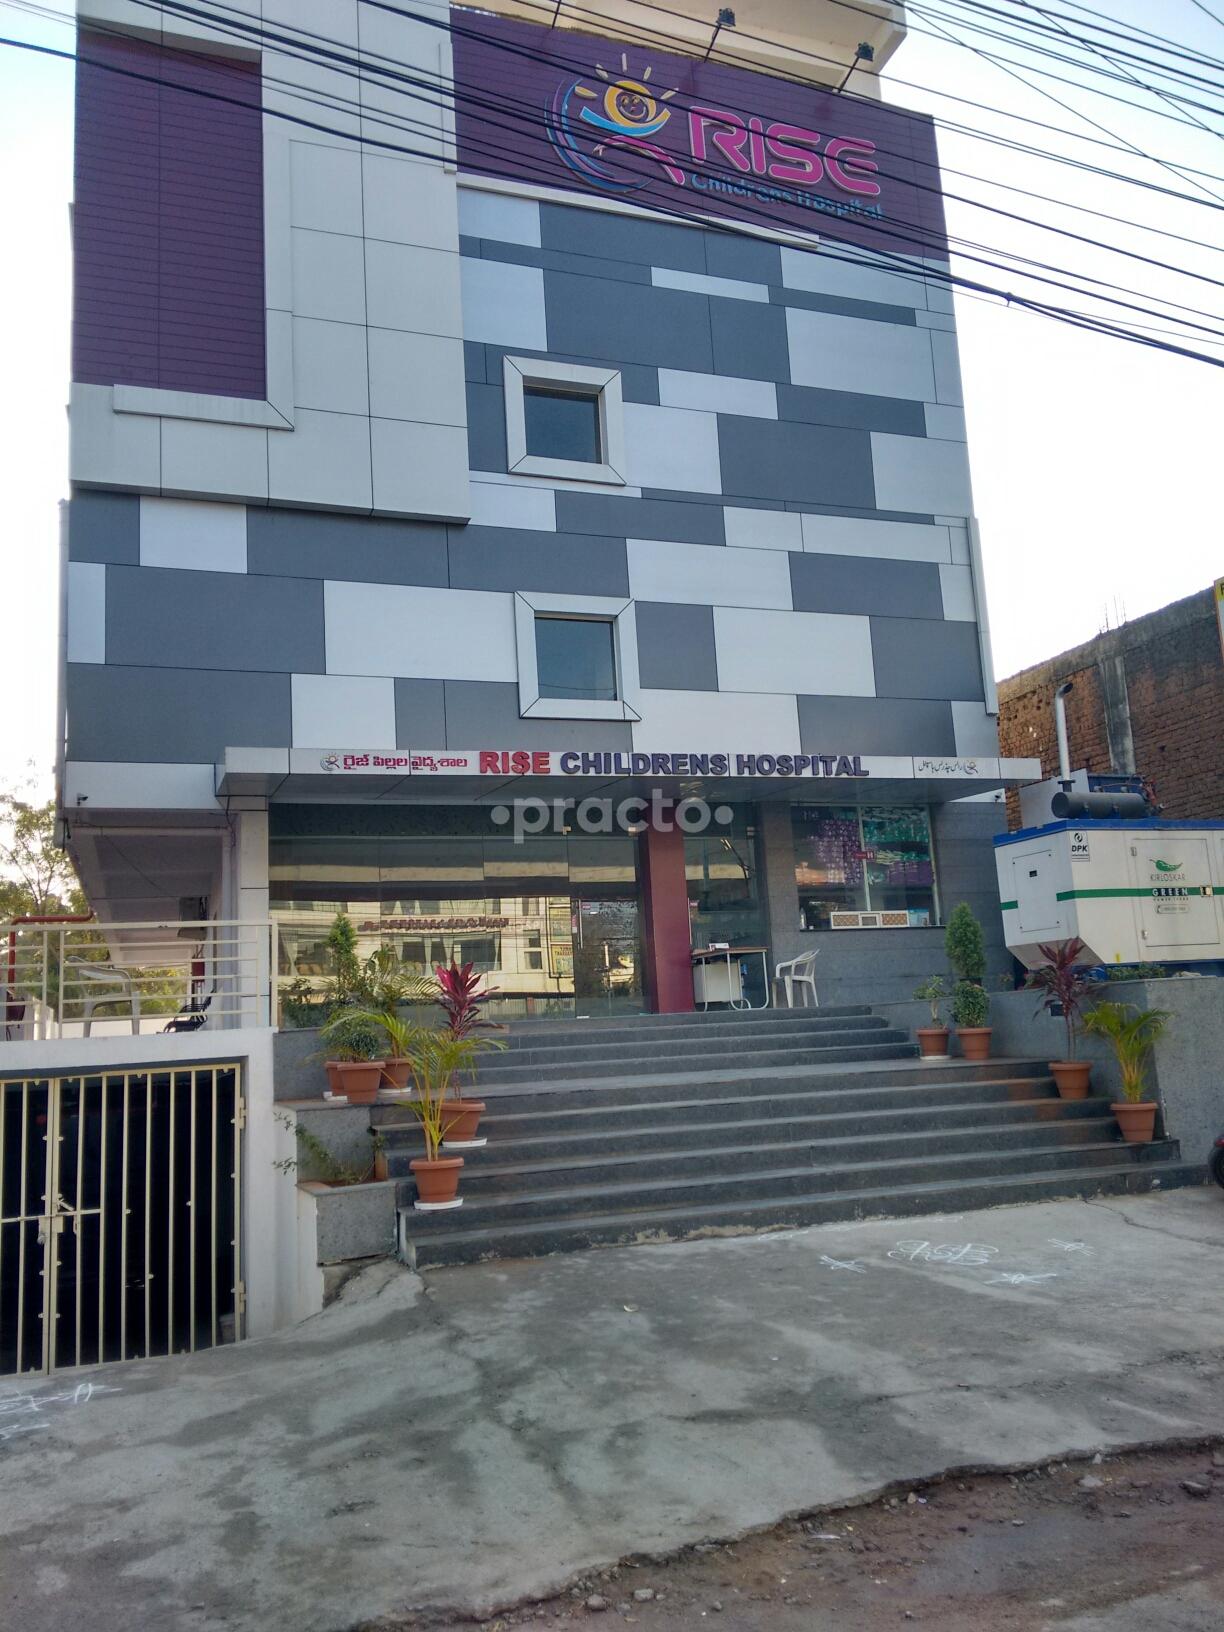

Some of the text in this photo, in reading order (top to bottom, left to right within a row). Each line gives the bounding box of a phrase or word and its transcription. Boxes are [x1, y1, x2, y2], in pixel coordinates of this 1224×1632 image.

[688, 106, 881, 195] RISE
[373, 755, 408, 770] పిల్లల
[479, 751, 870, 777] RISE CHILDRENS HOSPITAL
[1071, 844, 1088, 852] DPK
[1152, 888, 1189, 897] GREEN
